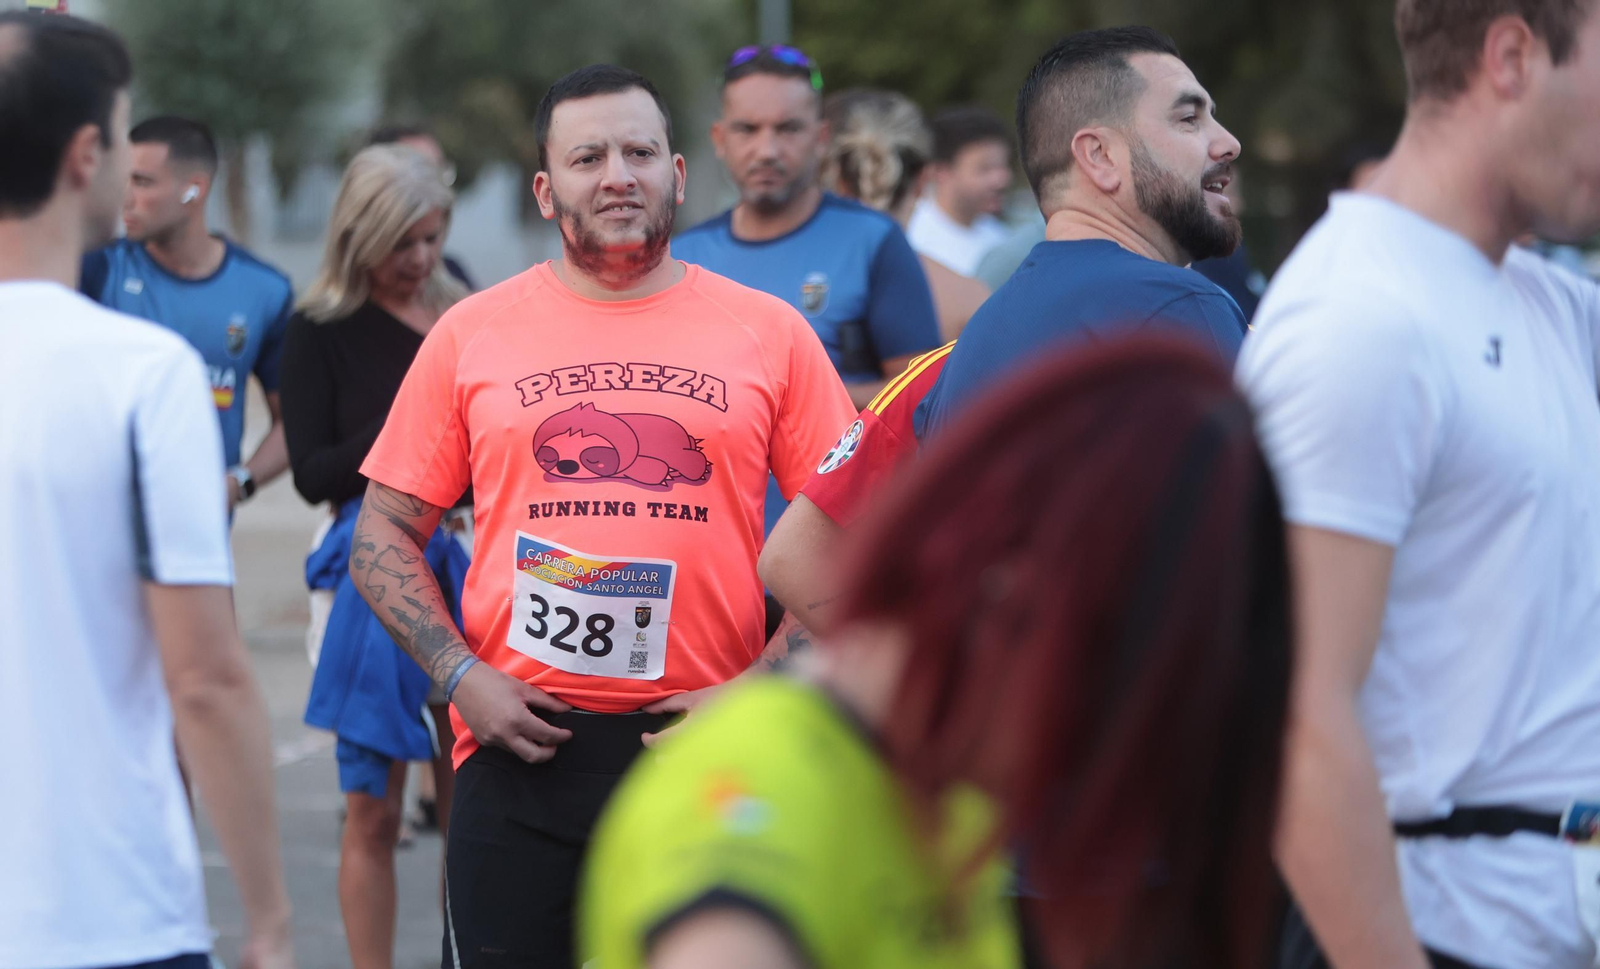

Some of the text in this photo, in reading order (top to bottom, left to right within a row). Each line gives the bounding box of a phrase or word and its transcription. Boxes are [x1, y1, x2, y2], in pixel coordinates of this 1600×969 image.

[515, 362, 728, 413] PEREZA
[529, 501, 709, 522] RUNNING TEAM
[523, 561, 664, 595] ASOCIACION SANTO ANGEL
[526, 548, 659, 583] CARRERA POPULAR
[525, 593, 615, 657] 328
